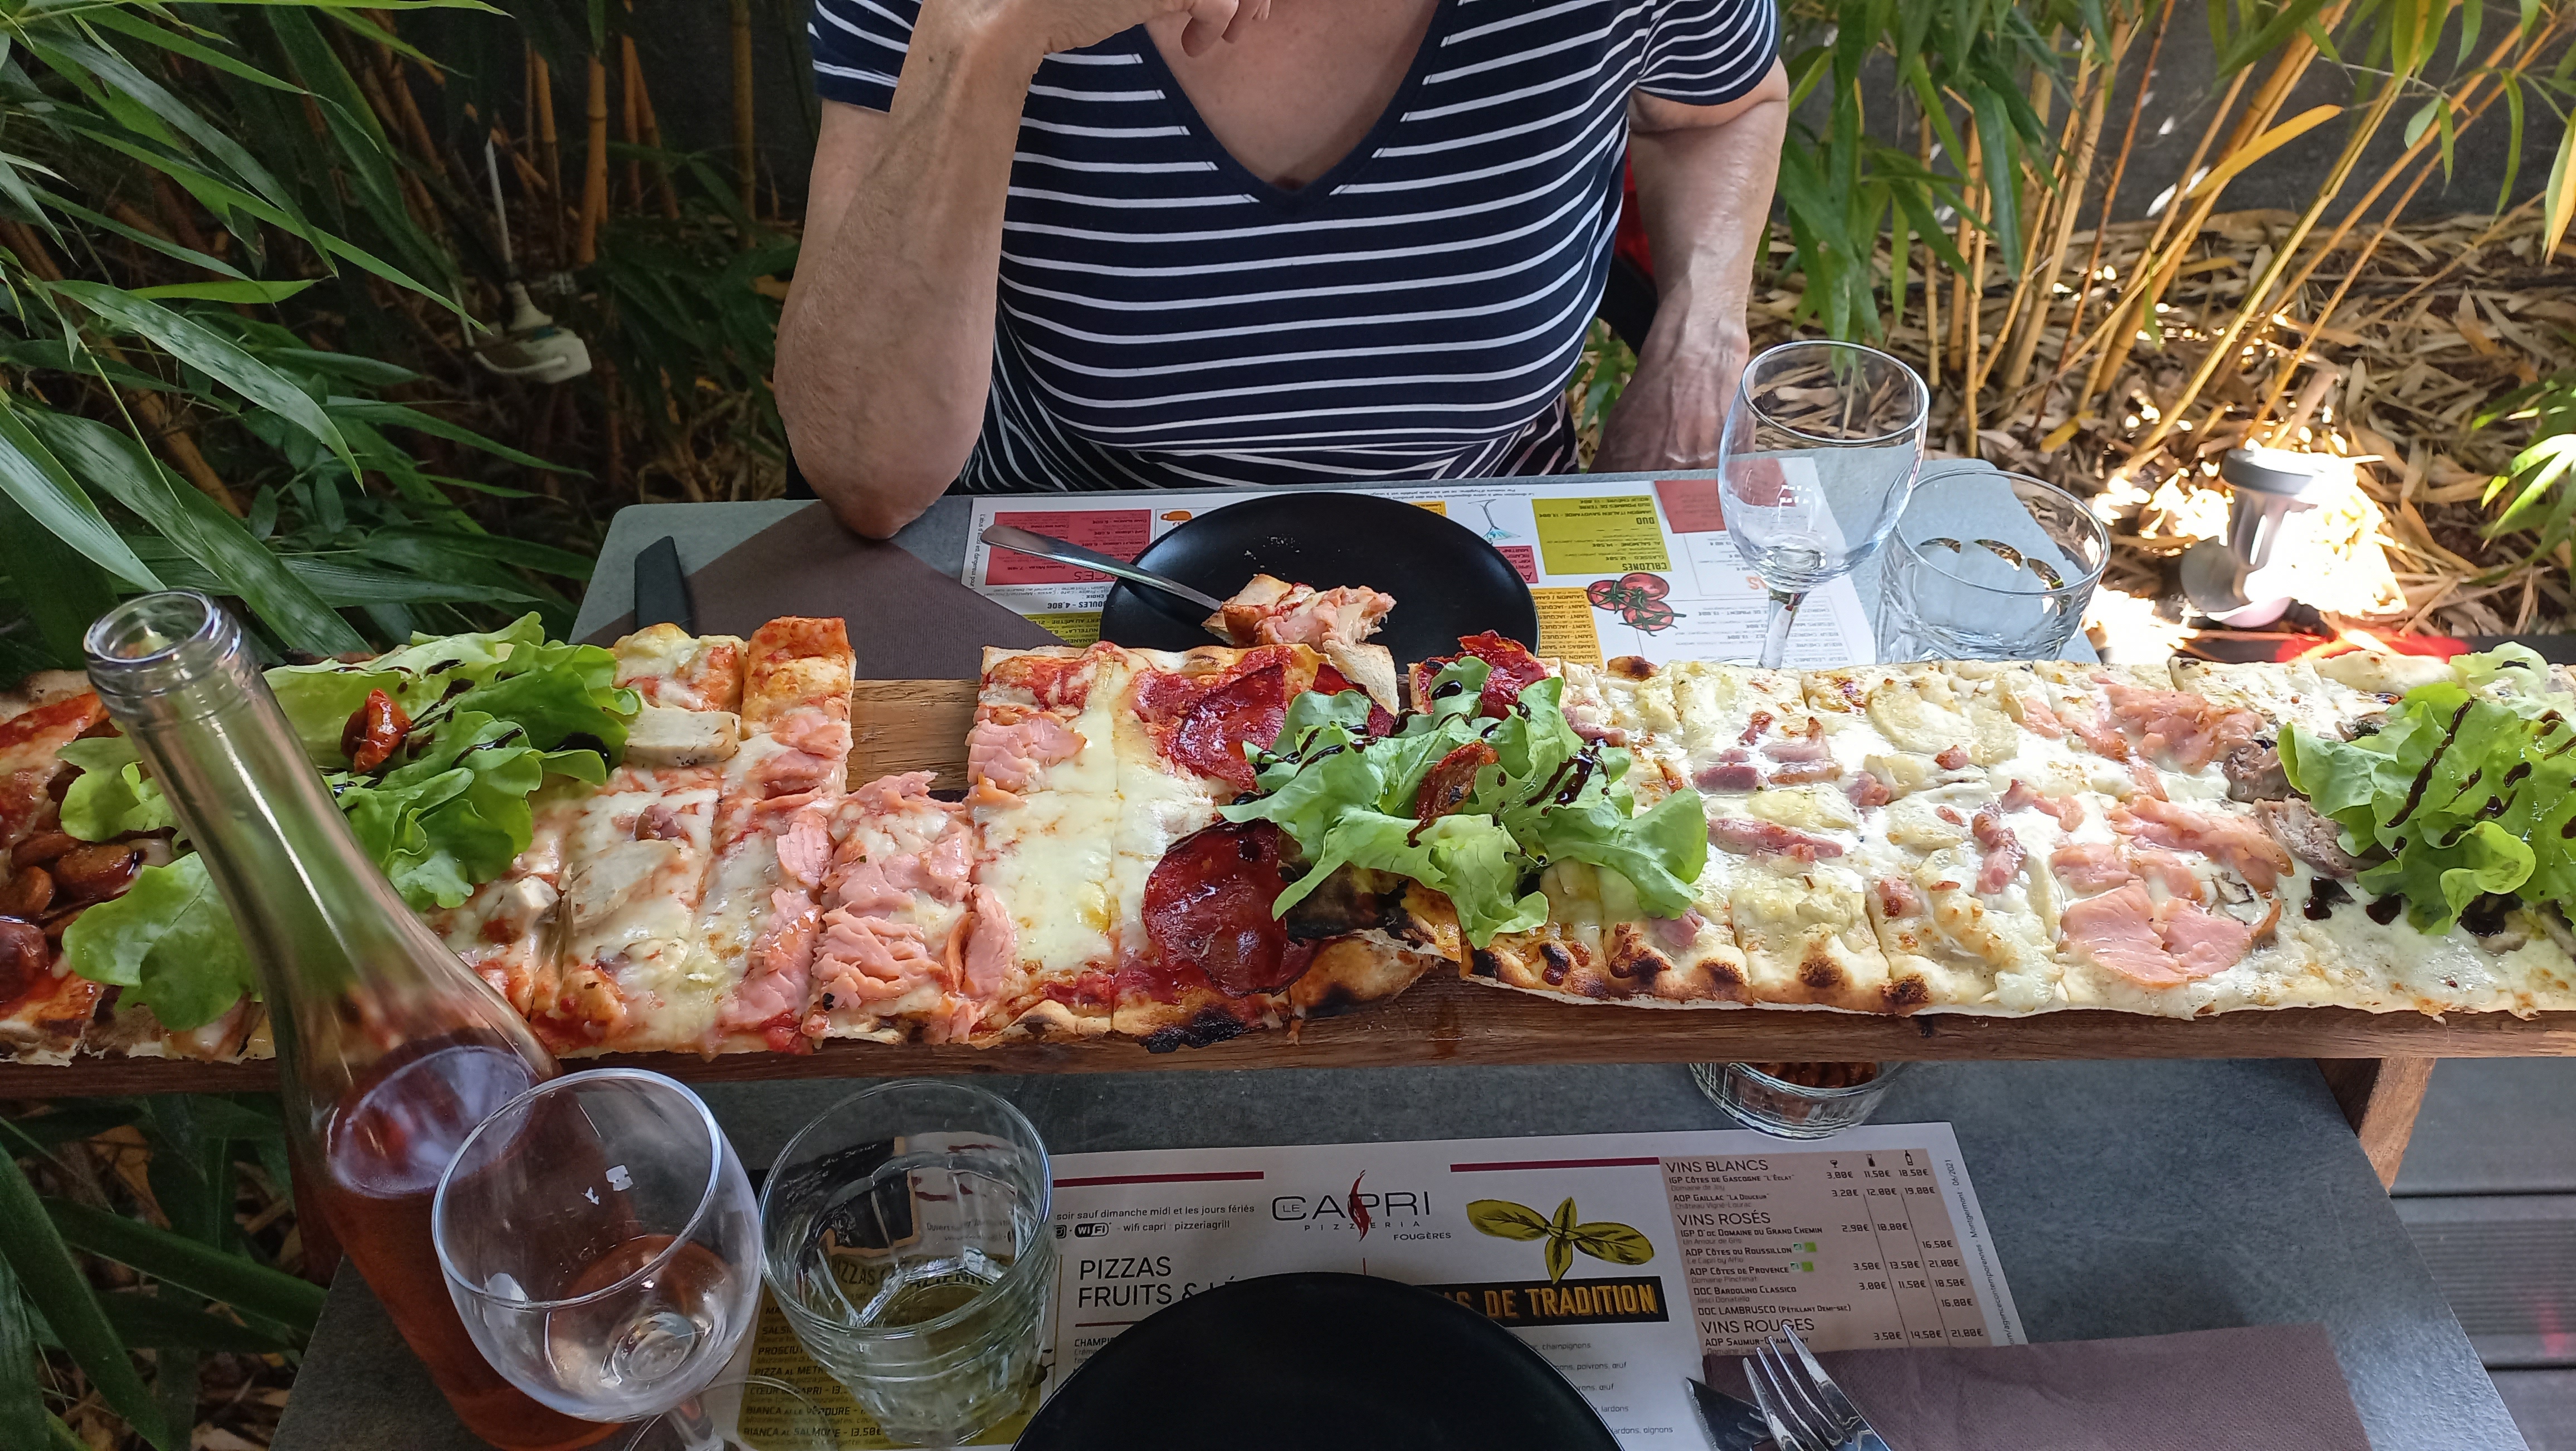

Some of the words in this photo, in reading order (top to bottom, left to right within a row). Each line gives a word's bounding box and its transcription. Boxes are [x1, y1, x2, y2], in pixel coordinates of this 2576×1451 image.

[1636, 517, 1655, 525] DUO
[1622, 562, 1667, 571] CALZONES
[1665, 1161, 1702, 1173] VINS
[1705, 1159, 1769, 1172] BLANCS
[1944, 1160, 1959, 1186] 06/2021
[1686, 1175, 1709, 1184] CÔTES
[1272, 1191, 1431, 1221] CAPRI
[1282, 1204, 1300, 1213] LE
[1056, 1211, 1075, 1221] soir
[1077, 1210, 1098, 1219] sauf
[1100, 1207, 1148, 1219] dimanche
[1150, 1206, 1171, 1216] midi
[1185, 1205, 1199, 1215] les
[1201, 1205, 1226, 1216] jours
[1228, 1204, 1255, 1214] fériés
[1677, 1213, 1715, 1226] VINS
[1718, 1209, 1771, 1225] ROSÉS
[1957, 1191, 1978, 1238] Montgermont
[1123, 1223, 1140, 1232] wifi
[1143, 1223, 1167, 1233] capri
[1174, 1220, 1230, 1231] pizzeriagrill
[1304, 1221, 1421, 1231] PIZZERIA
[1765, 1227, 1792, 1235] GRAND
[1393, 1231, 1451, 1241] FOUGÈRES
[1706, 1248, 1730, 1256] CÔTES
[1079, 1256, 1172, 1280] PIZZAS
[1710, 1267, 1735, 1275] CÔTES
[1748, 1266, 1790, 1274] PROVENCE
[1078, 1282, 1173, 1308] FRUITS
[1693, 1287, 1712, 1296] DOC
[1714, 1286, 1758, 1295] BARDOLINO
[1976, 1244, 2015, 1346] om/agencecontemporennes
[1484, 1289, 1520, 1319] DE
[1524, 1284, 1658, 1318] TRADITION
[1697, 1307, 1716, 1316] DOC
[1718, 1305, 1776, 1315] LAMBRUSCO
[1700, 1320, 1740, 1335] VINS
[1743, 1317, 1815, 1333] ROUGES
[1705, 1338, 1724, 1347] AOP
[1612, 1361, 1627, 1370] œuf
[754, 1367, 783, 1376] PIZZA
[1598, 1383, 1614, 1391] œuf
[1643, 1426, 1674, 1435] oignons
